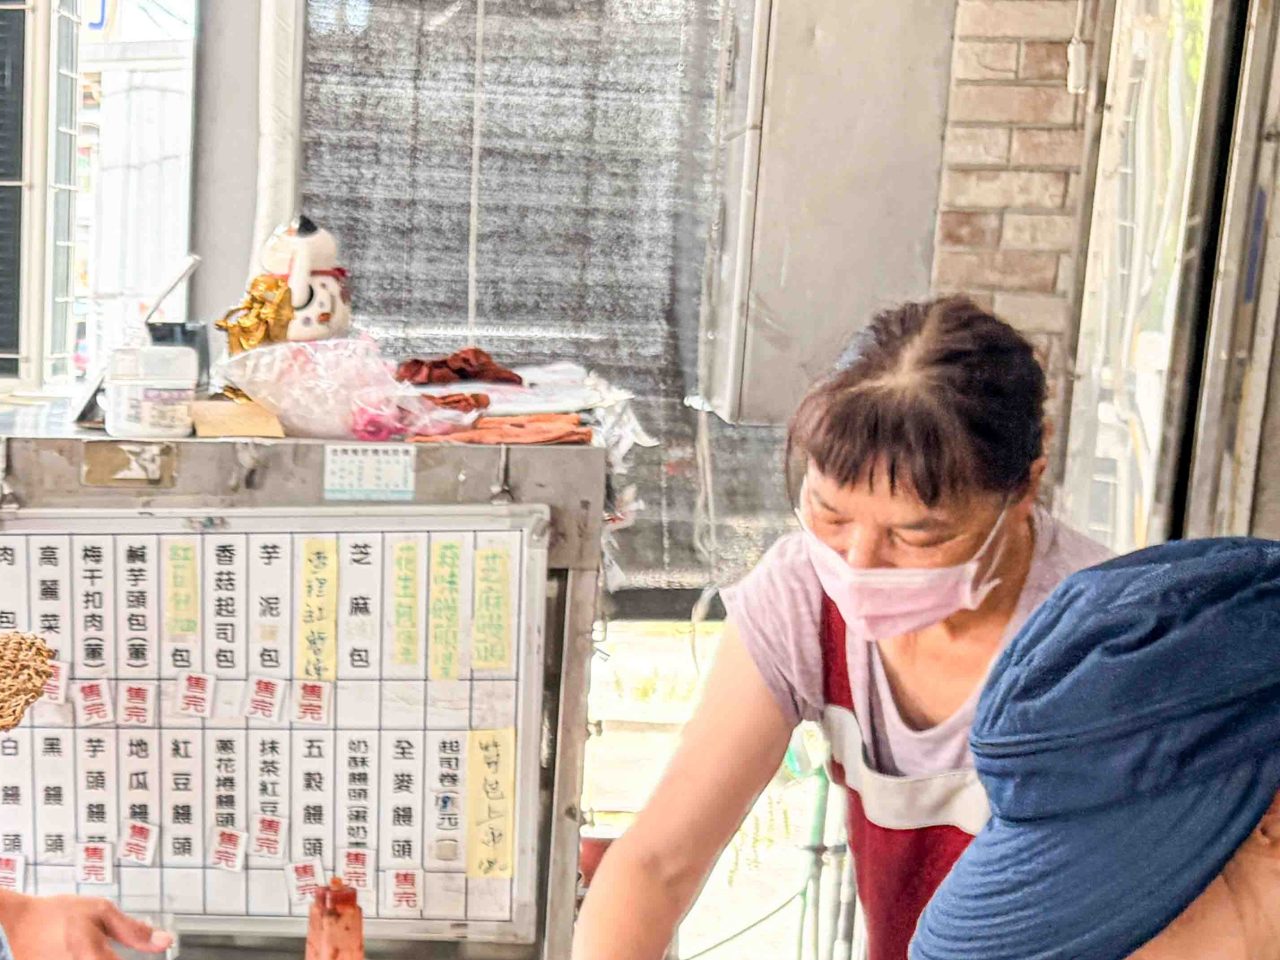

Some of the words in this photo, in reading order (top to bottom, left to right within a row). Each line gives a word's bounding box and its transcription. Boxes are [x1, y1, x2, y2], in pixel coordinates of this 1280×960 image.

[214, 544, 236, 669] 香菇起司包
[259, 544, 281, 668] 芋泥包
[349, 543, 372, 668] 芝麻包
[80, 683, 107, 721] 售完
[124, 686, 149, 723] 售完
[181, 675, 208, 714] 售完
[249, 679, 277, 719] 售完
[297, 683, 323, 721] 售完
[1, 737, 22, 853] 白饅頭
[42, 737, 65, 853] 黑饅頭
[171, 739, 193, 857] 紅豆饅頭
[303, 739, 325, 857] 五穀饅頭
[392, 740, 415, 859] 全麥饅頭
[122, 823, 151, 862] 售完
[212, 831, 241, 869] 售完
[256, 818, 282, 856] 售完
[82, 846, 106, 881] 售完
[344, 852, 368, 889] 售完
[392, 872, 418, 909] 售完
